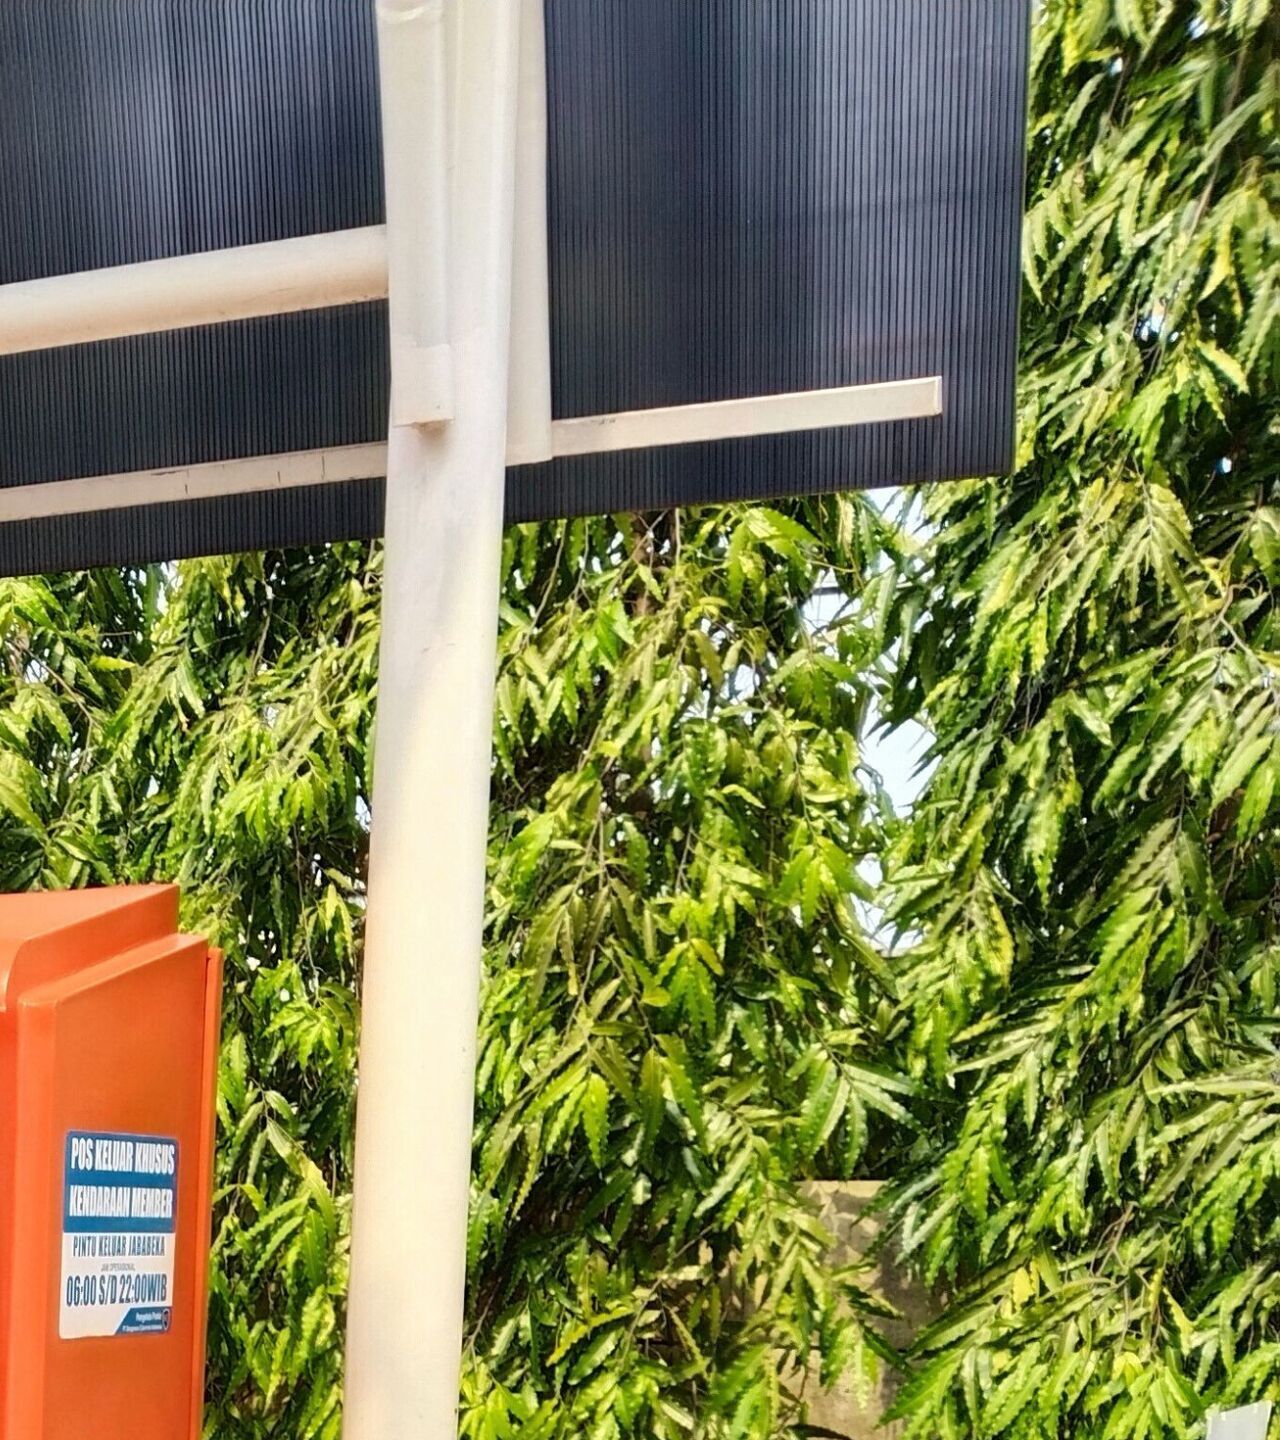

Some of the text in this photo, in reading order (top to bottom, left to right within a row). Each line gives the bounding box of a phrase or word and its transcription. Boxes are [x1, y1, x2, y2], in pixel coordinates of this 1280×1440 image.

[71, 1137, 175, 1175] POS KELUAR KHUSUS
[69, 1185, 172, 1218] KENDARAAN MEMBER
[66, 1275, 96, 1307] 06:00
